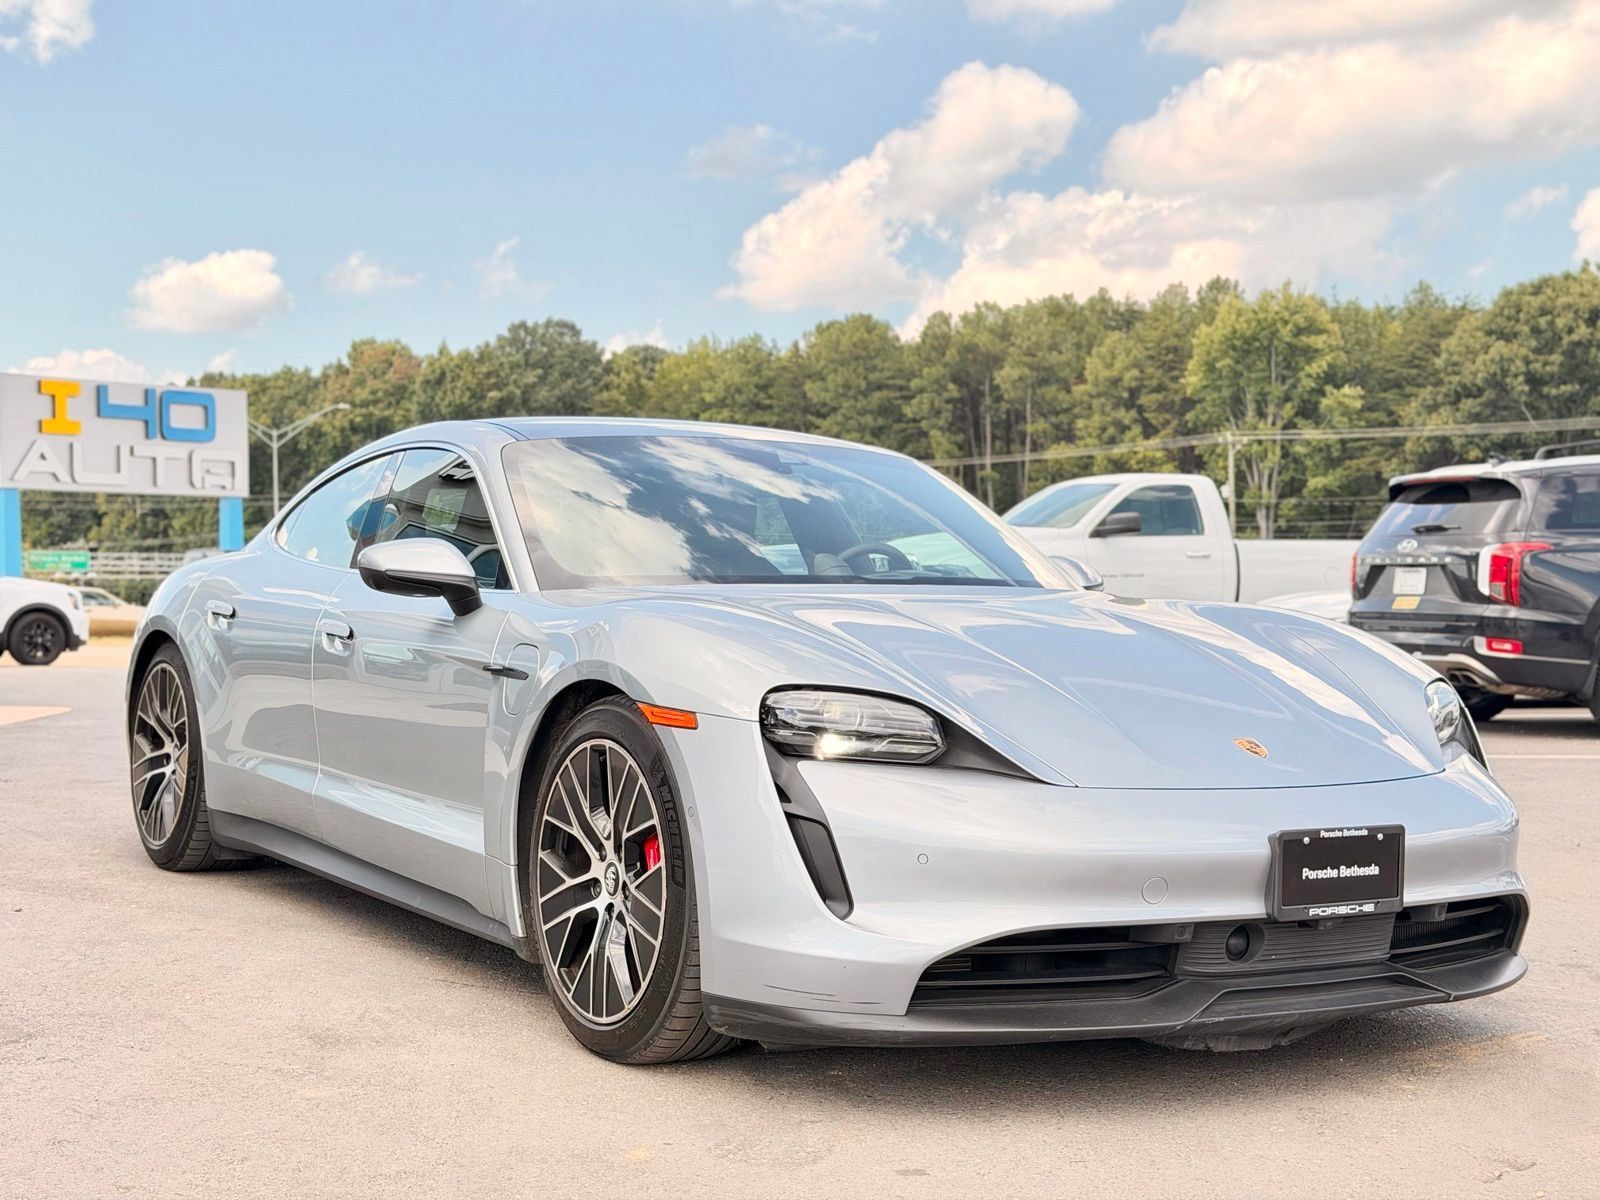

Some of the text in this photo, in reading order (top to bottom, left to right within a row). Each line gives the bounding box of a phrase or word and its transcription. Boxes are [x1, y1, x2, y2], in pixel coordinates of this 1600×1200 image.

[38, 380, 216, 443] I 40
[1320, 828, 1368, 838] Porsche Bethesda
[1302, 864, 1380, 880] Porsche Bethesda
[1309, 904, 1375, 917] PORSCHE
